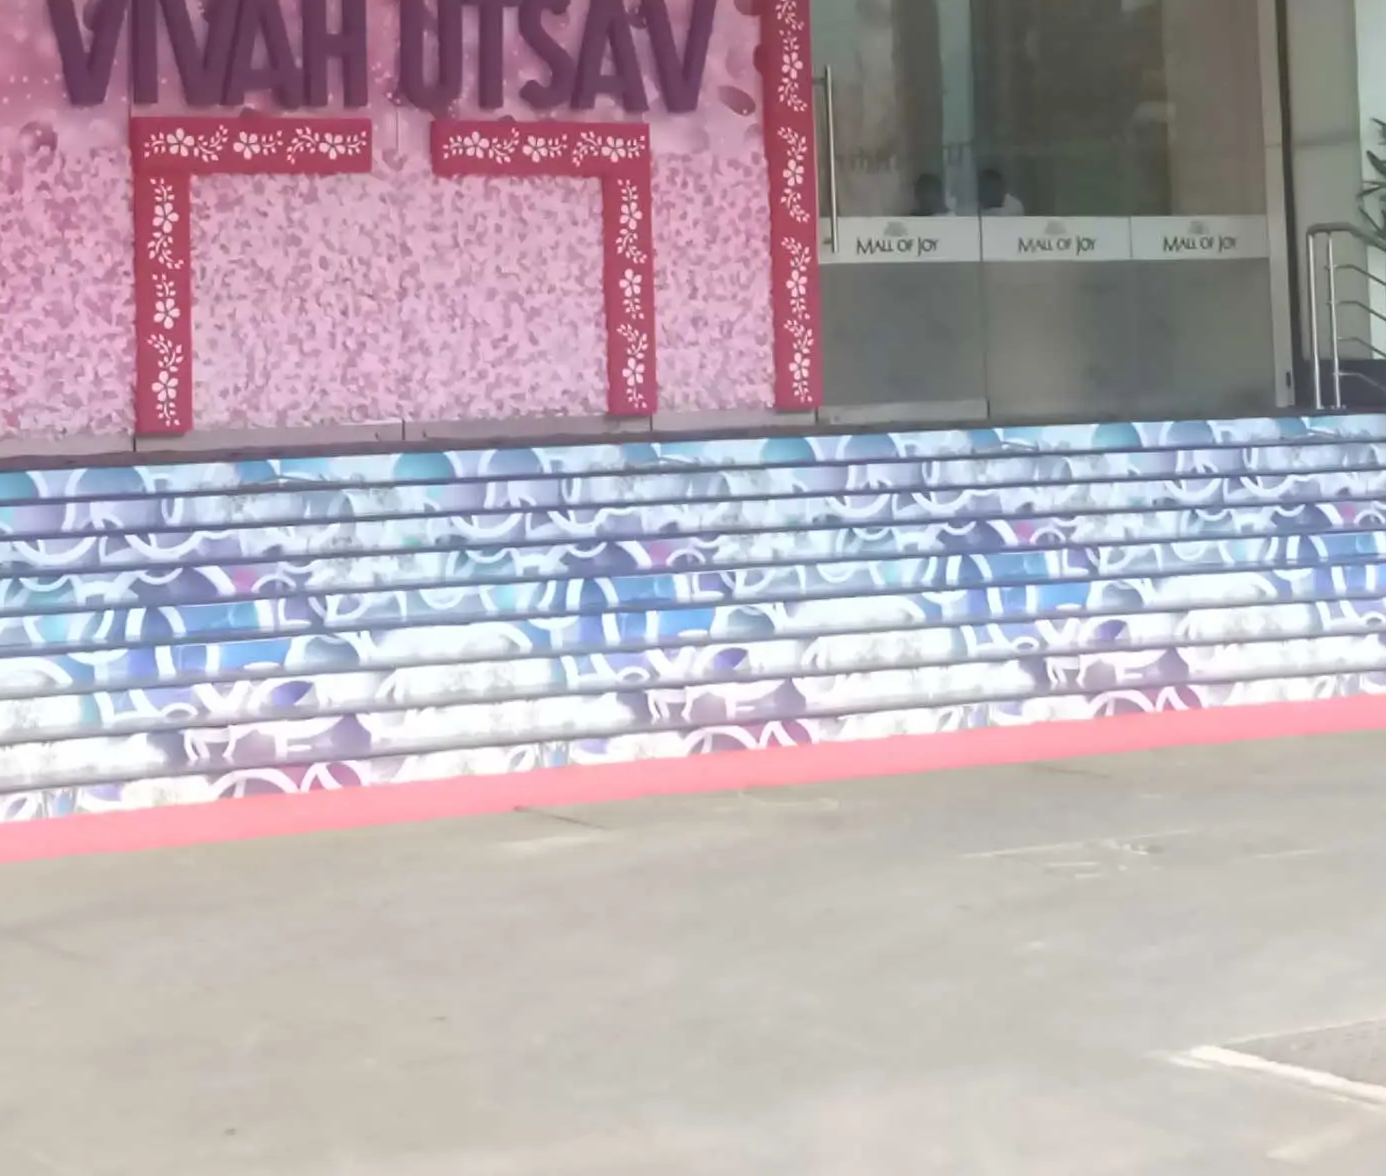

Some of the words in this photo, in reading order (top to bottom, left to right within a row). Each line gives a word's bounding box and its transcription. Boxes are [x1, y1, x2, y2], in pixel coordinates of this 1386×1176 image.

[856, 236, 893, 255] MALL
[897, 238, 914, 253] OF
[917, 236, 939, 257] JOY
[1018, 237, 1053, 254] MALL
[1056, 237, 1072, 252] OF
[1075, 235, 1097, 256] JOY
[1163, 235, 1197, 252] MALL
[1199, 236, 1215, 250] OF
[1217, 235, 1237, 253] JOY
